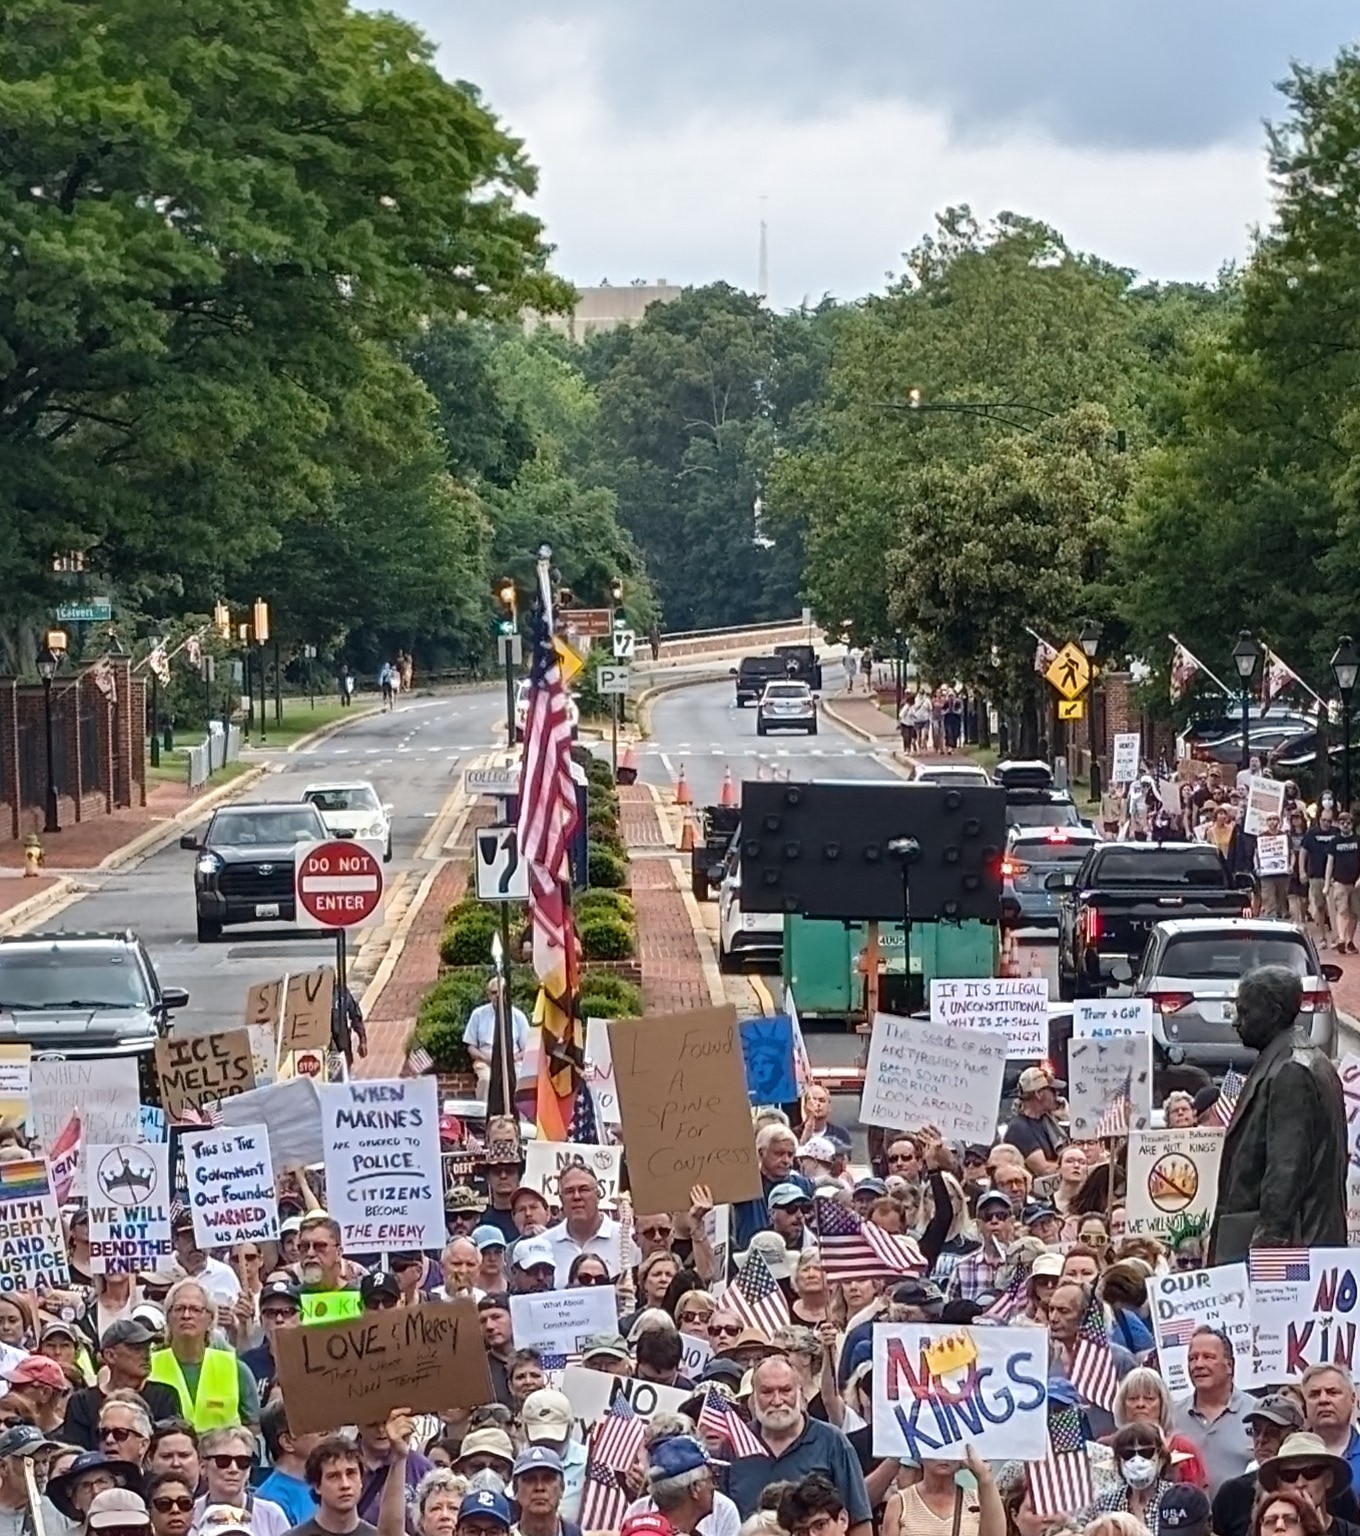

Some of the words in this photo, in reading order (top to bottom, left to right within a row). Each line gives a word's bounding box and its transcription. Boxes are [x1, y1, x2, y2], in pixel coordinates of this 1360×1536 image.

[61, 608, 93, 618] Calvert
[468, 772, 509, 783] COLLEGE
[309, 858, 330, 872] DO
[339, 857, 369, 871] NOT
[316, 896, 364, 910] ENTER
[995, 982, 1046, 996] ILLEGAL
[946, 1018, 975, 1028] WHY
[168, 1034, 231, 1067] ICE
[299, 1060, 320, 1071] STOP
[42, 1065, 92, 1085] WHEN
[162, 1056, 248, 1096] MELTS
[669, 1069, 684, 1094] A
[349, 1084, 405, 1103] WHEN
[336, 1108, 423, 1129] MARINES
[405, 1137, 421, 1147] TO
[1139, 1146, 1157, 1156] ARE
[1163, 1142, 1181, 1155] NOT
[1190, 1143, 1217, 1153] KINGS
[347, 1185, 432, 1201] CITIZENS
[91, 1207, 118, 1223] WE
[203, 1207, 266, 1228] WARNED
[365, 1205, 408, 1217] BECOME
[109, 1224, 148, 1239] NOT
[344, 1224, 372, 1239] THE
[378, 1224, 426, 1239] ENEMY
[1128, 1221, 1146, 1234] WE
[1146, 1218, 1166, 1232] WILL
[2, 1237, 45, 1257] AND
[90, 1241, 137, 1257] BEND
[137, 1240, 171, 1255] THE
[105, 1257, 157, 1276] KNEE!
[33, 1269, 69, 1289] ALL
[1160, 1273, 1210, 1293] OUR
[1313, 1267, 1358, 1313] NO
[543, 1301, 560, 1310] What
[563, 1298, 584, 1308] About
[558, 1310, 570, 1318] the
[1206, 1311, 1220, 1320] IN
[543, 1319, 590, 1330] Constitution?
[302, 1325, 386, 1374] LOVE
[608, 1376, 658, 1415] NO
[893, 1352, 1047, 1461] KINGS
[1160, 1507, 1187, 1520] USA
